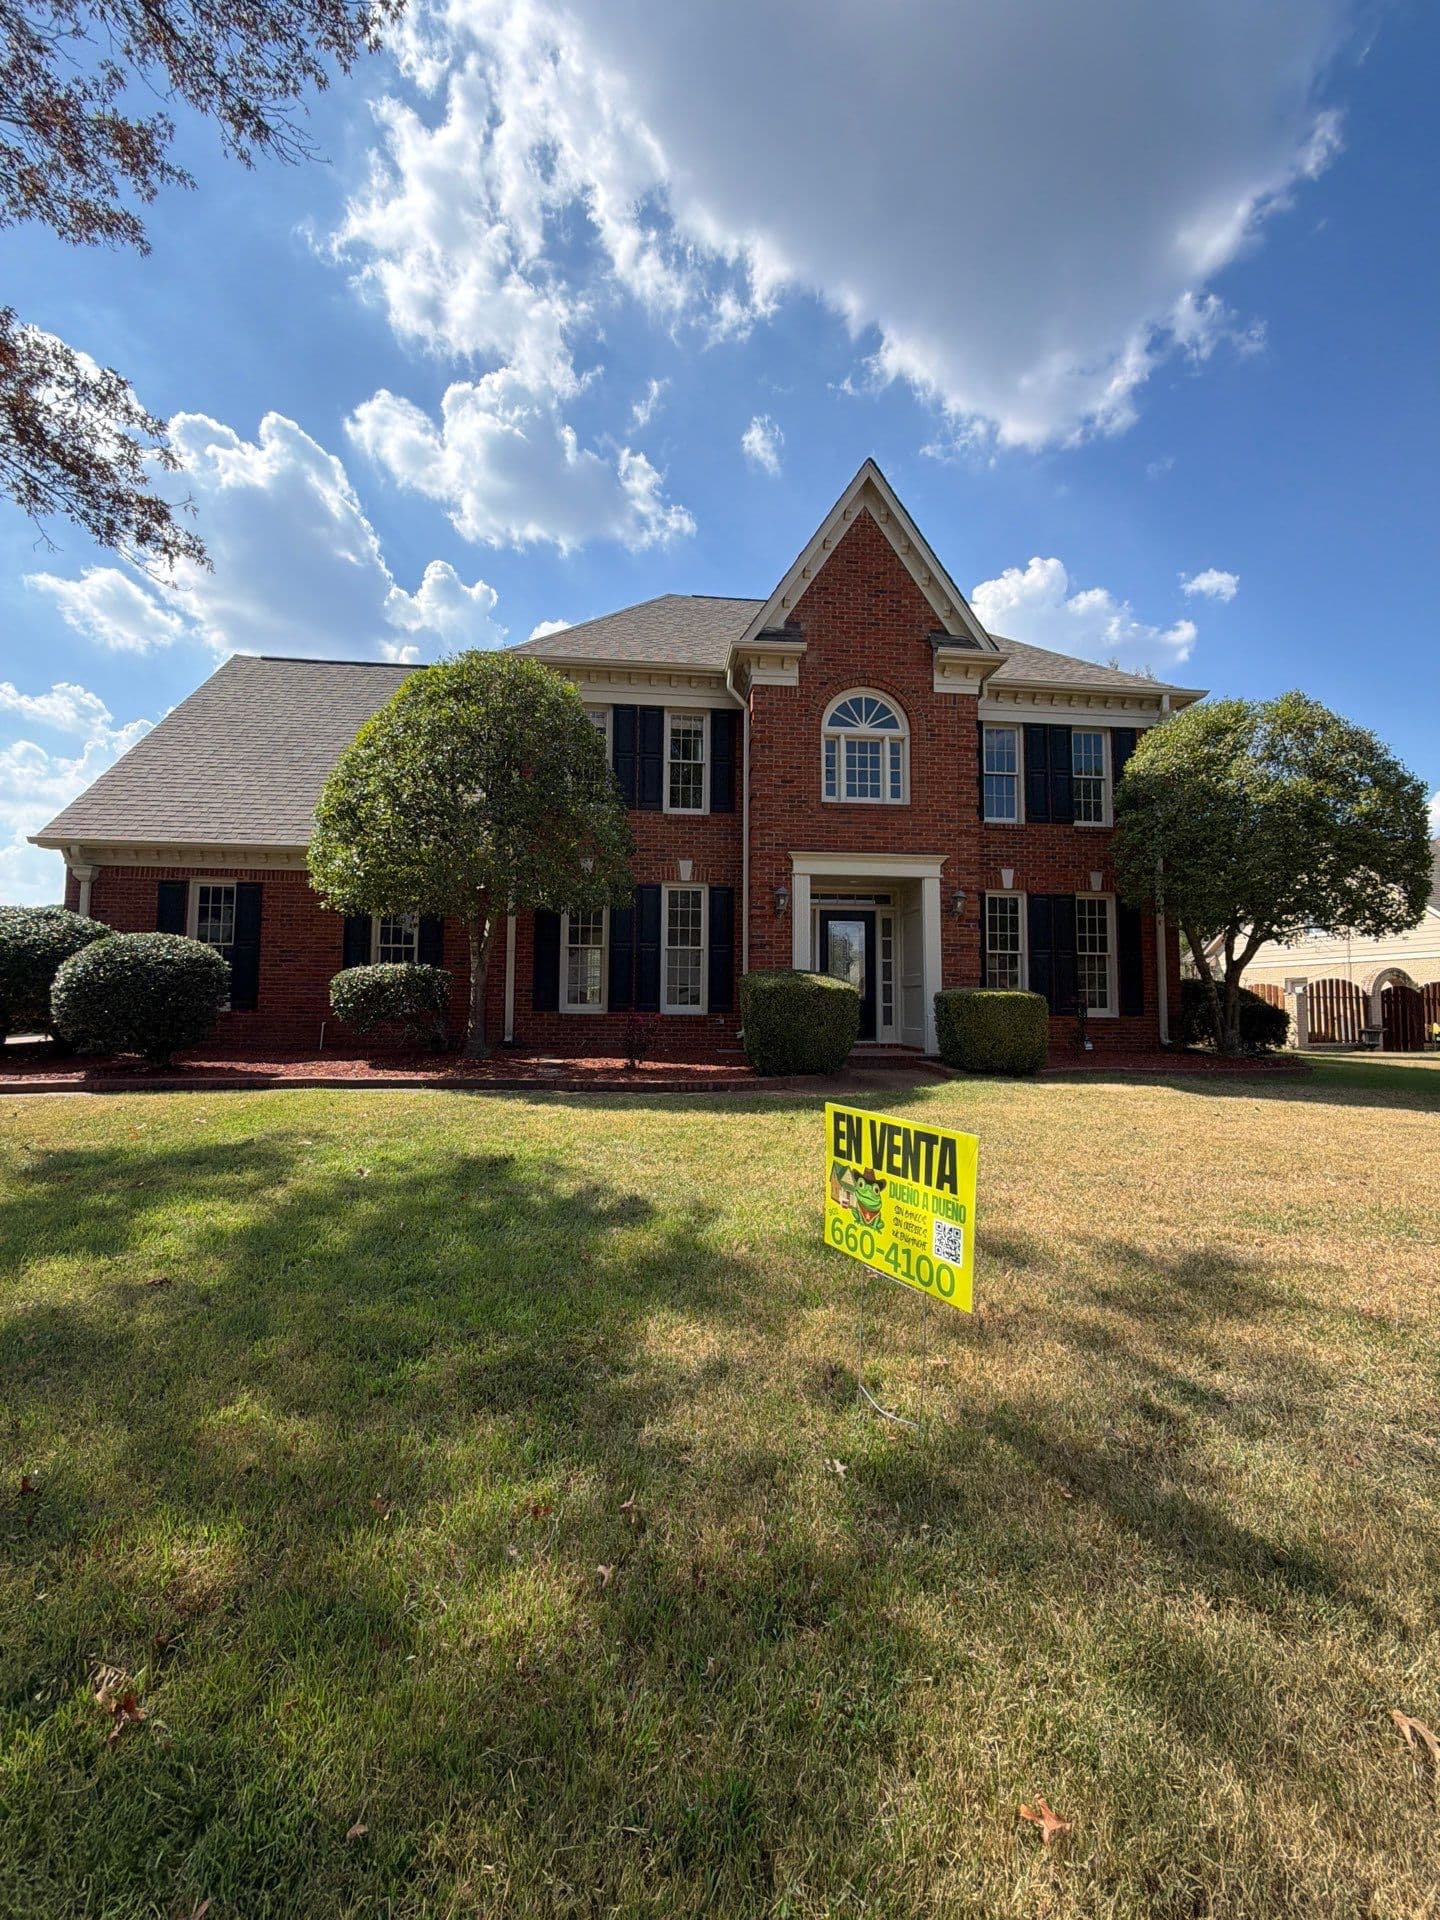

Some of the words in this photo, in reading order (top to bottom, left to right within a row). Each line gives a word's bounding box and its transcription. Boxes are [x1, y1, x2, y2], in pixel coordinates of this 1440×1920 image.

[833, 1111, 863, 1165] EN
[869, 1119, 958, 1196] VENTA
[889, 1180, 920, 1208] DUEÑO
[921, 1191, 930, 1212] A
[931, 1194, 967, 1225] DUEÑO
[831, 1217, 956, 1298] 660-4100
